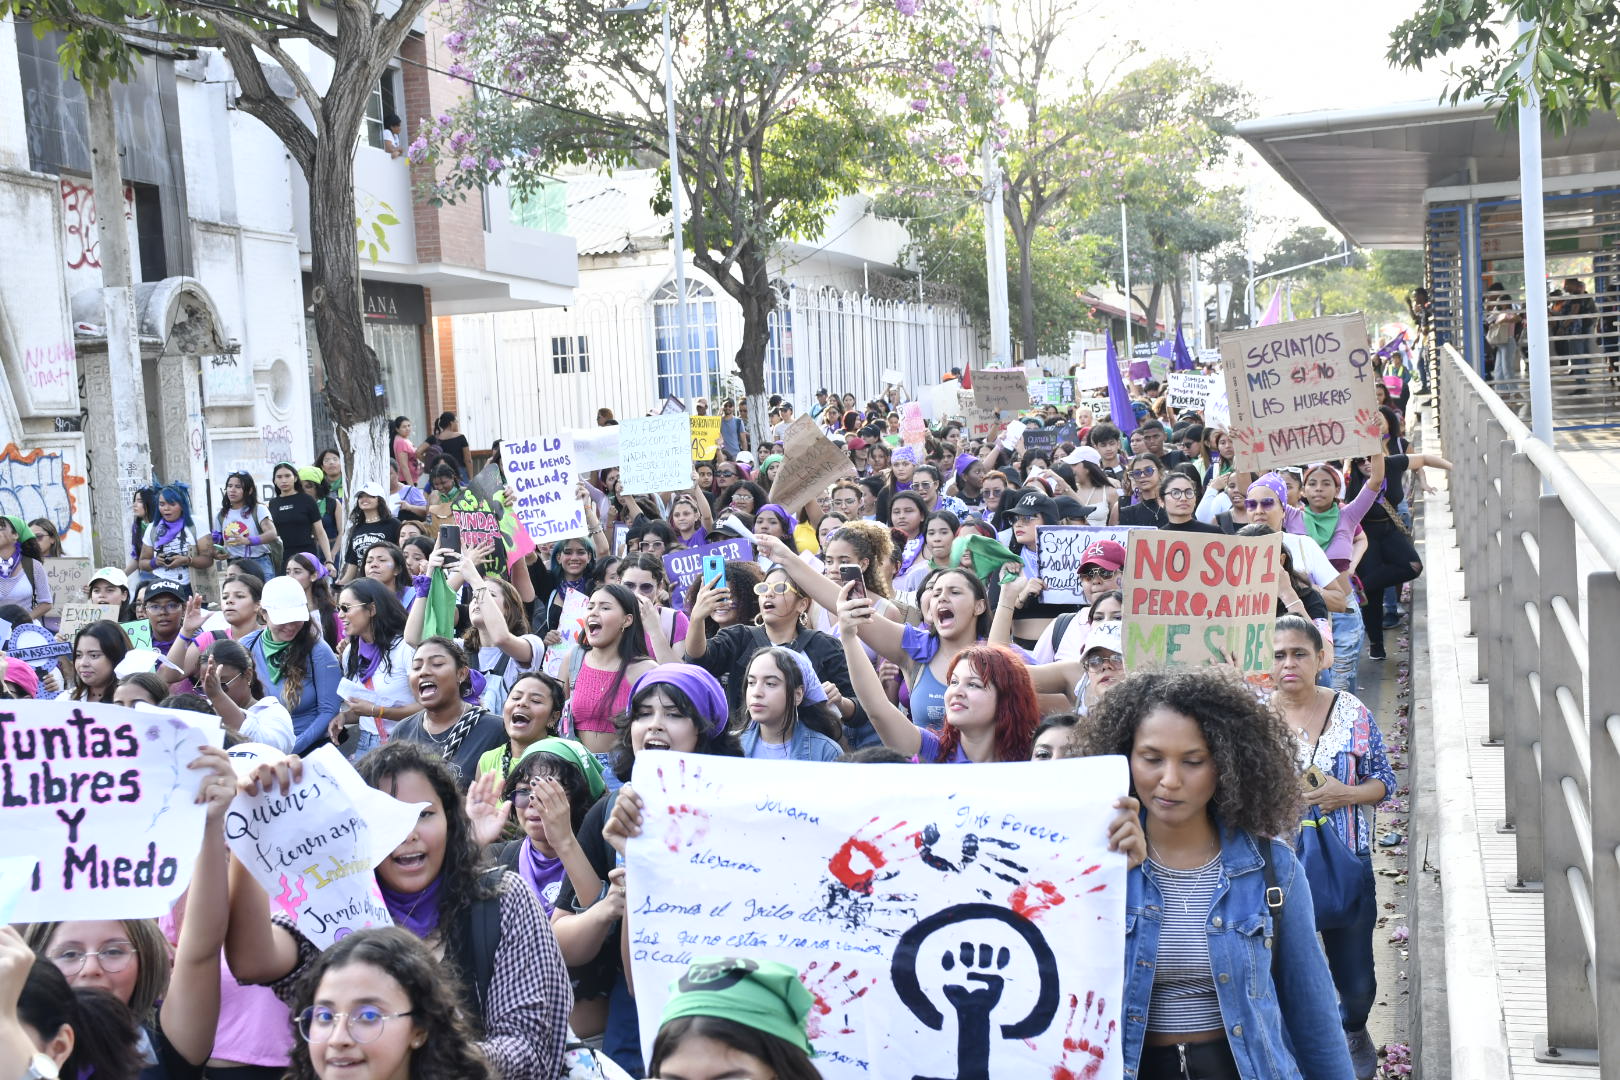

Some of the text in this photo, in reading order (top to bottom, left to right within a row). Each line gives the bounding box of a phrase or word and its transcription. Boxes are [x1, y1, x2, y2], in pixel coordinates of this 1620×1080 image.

[1247, 332, 1341, 368] SERIAMOS
[1247, 368, 1281, 392] MAS
[1252, 397, 1285, 418] LAS
[543, 438, 561, 452] LO
[1268, 421, 1345, 456] MATADO
[508, 460, 536, 473] QUE
[516, 509, 546, 520] GRITA
[671, 554, 703, 574] QUE
[1134, 539, 1275, 587] NO SOY 1
[65, 608, 102, 622] EXISTO
[1132, 587, 1214, 620] PERRO,
[1251, 592, 1270, 615] NO
[1127, 621, 1191, 670] ME
[2, 761, 140, 808] Libres
[56, 807, 86, 843] Y
[63, 841, 178, 890] Miedo
